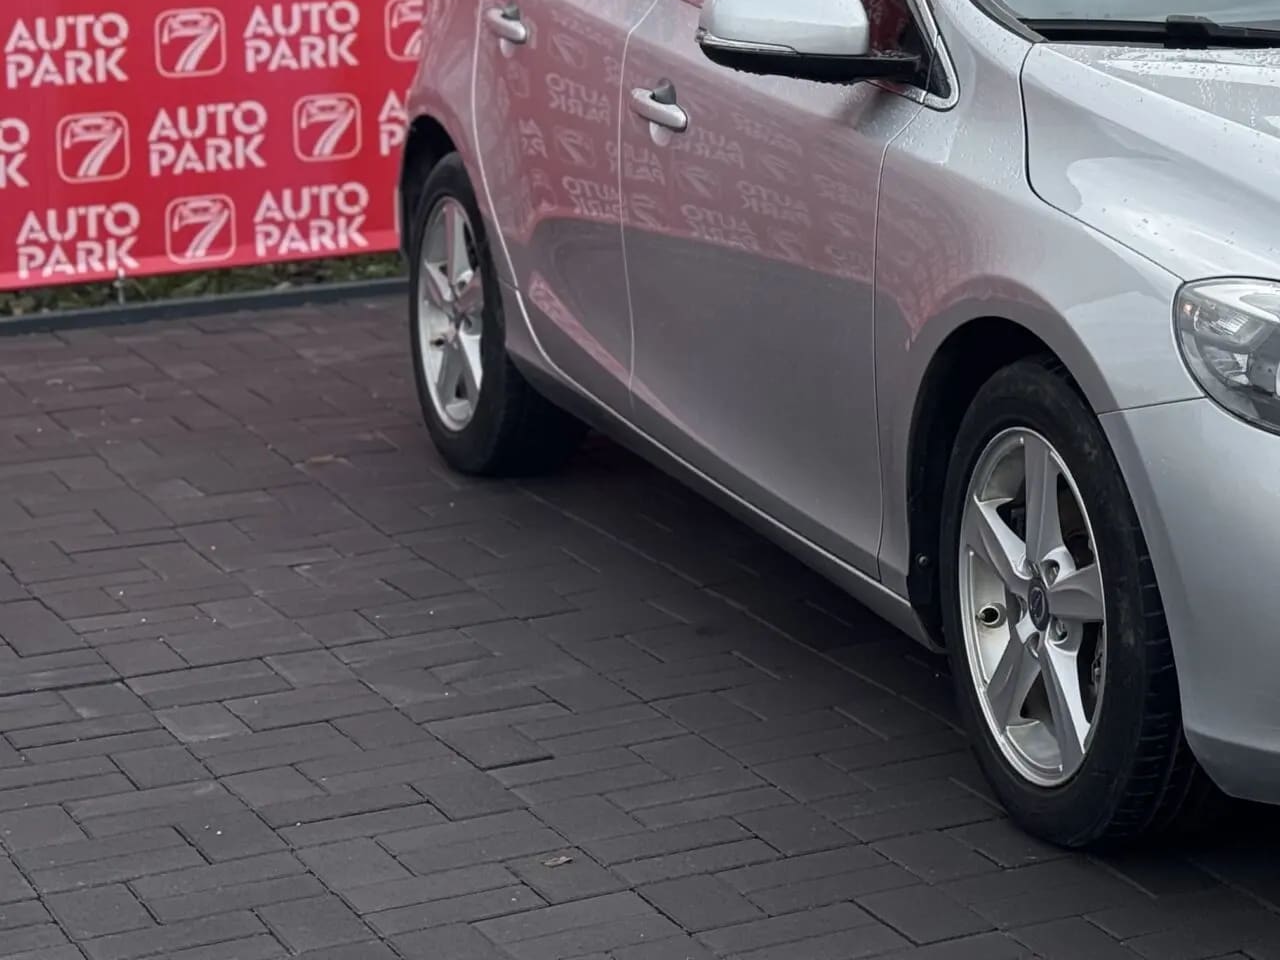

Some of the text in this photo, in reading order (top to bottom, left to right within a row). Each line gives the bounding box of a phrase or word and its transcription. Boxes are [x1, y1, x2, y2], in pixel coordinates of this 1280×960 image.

[5, 12, 129, 53] AUTO
[244, 0, 359, 39] AUTO
[6, 47, 128, 89] PARK
[245, 32, 358, 73] PARK
[148, 100, 267, 142] AUTO
[150, 133, 266, 177] PARK
[16, 202, 139, 245] AUTO
[254, 182, 368, 224] AUTO
[256, 214, 368, 258] PARK
[17, 236, 139, 279] PARK
